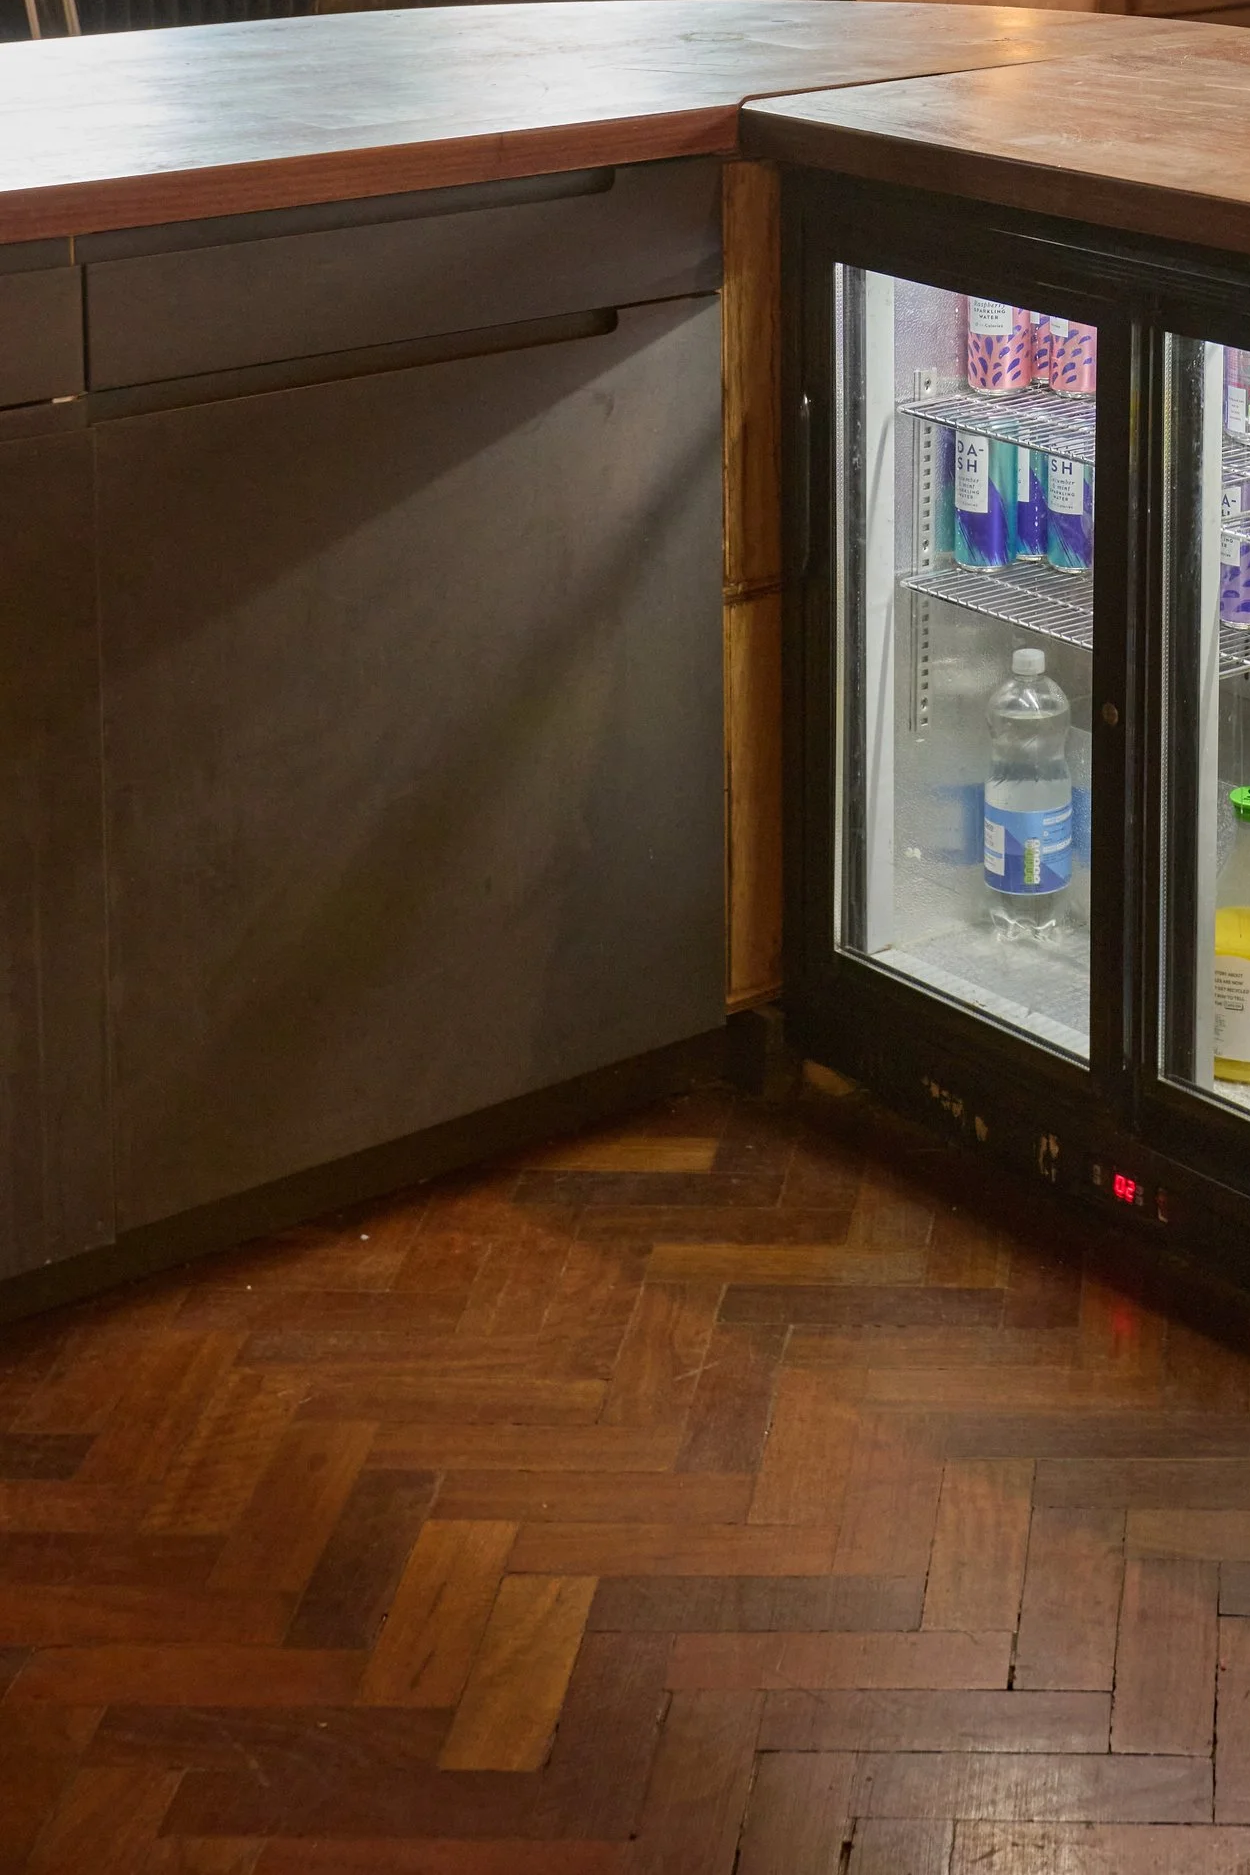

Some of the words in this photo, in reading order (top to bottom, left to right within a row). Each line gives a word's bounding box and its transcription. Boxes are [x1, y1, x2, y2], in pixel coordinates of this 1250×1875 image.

[957, 439, 985, 457] DA-
[957, 456, 977, 473] SH
[1051, 458, 1073, 475] SH
[1113, 1173, 1137, 1203] 02
